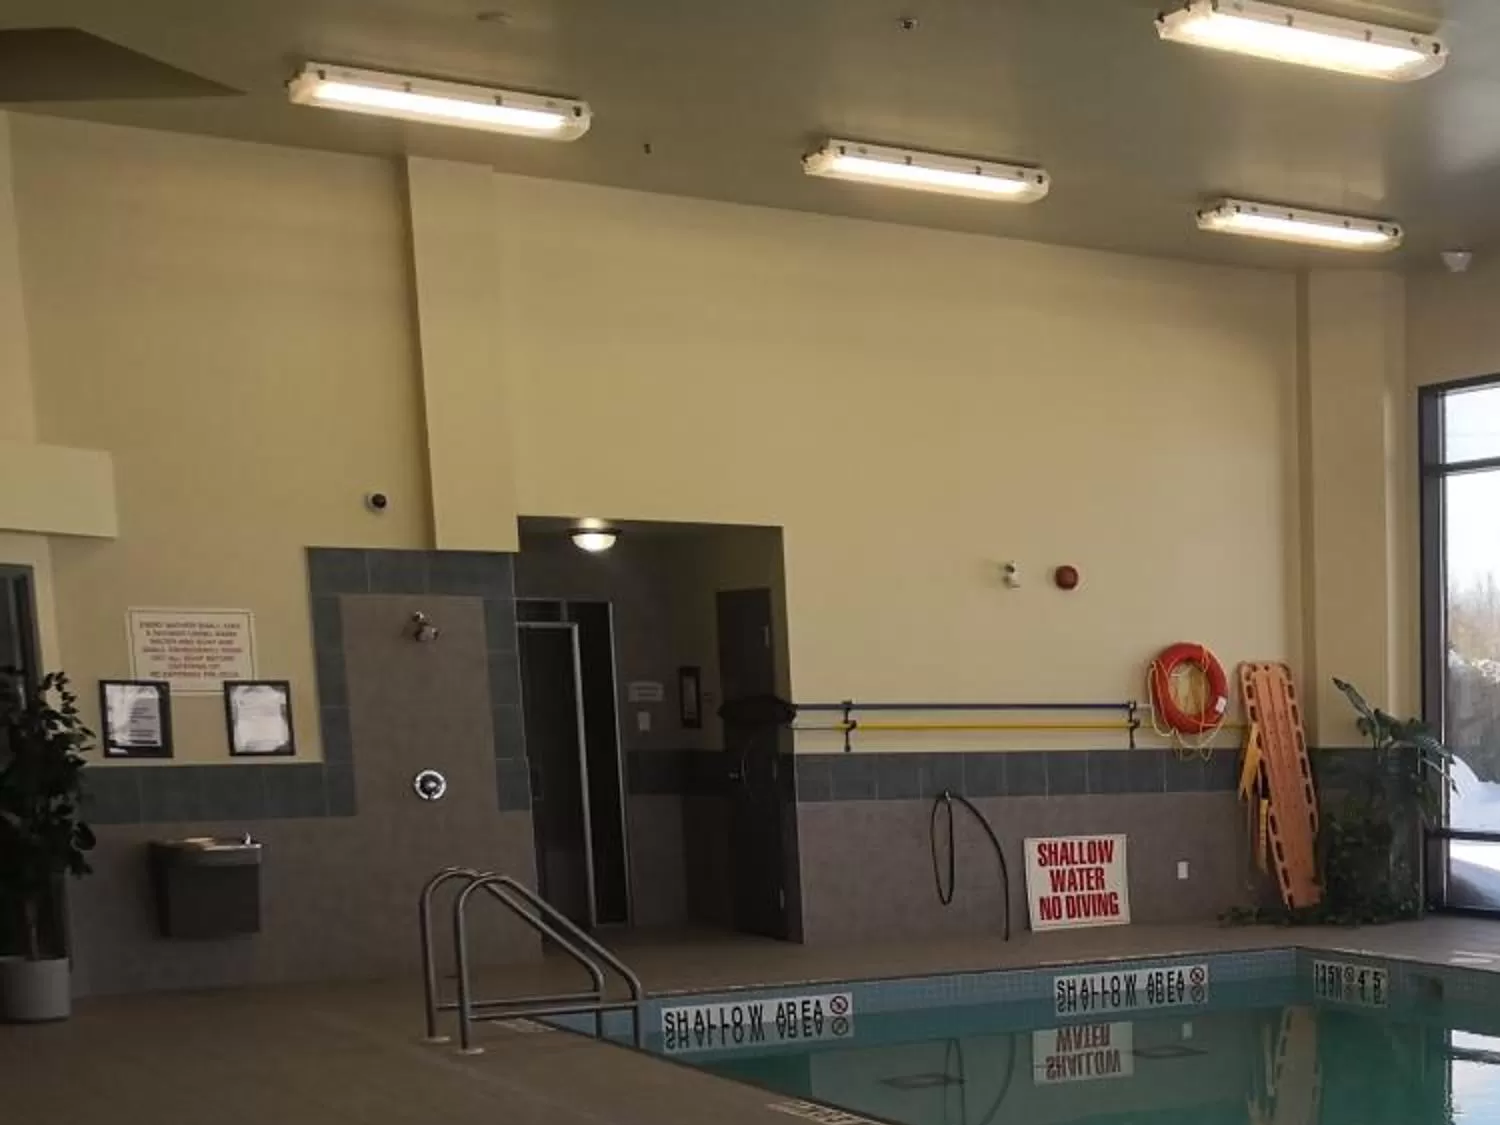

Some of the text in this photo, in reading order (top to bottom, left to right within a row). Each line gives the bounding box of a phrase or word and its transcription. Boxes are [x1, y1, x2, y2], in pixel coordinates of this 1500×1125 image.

[1037, 840, 1114, 867] SHALLOW
[1049, 867, 1105, 893] WATER
[1039, 892, 1120, 920] NO DIVING
[1057, 969, 1185, 994] SHALLOW AREA
[664, 999, 824, 1031] SHALLOW AREA
